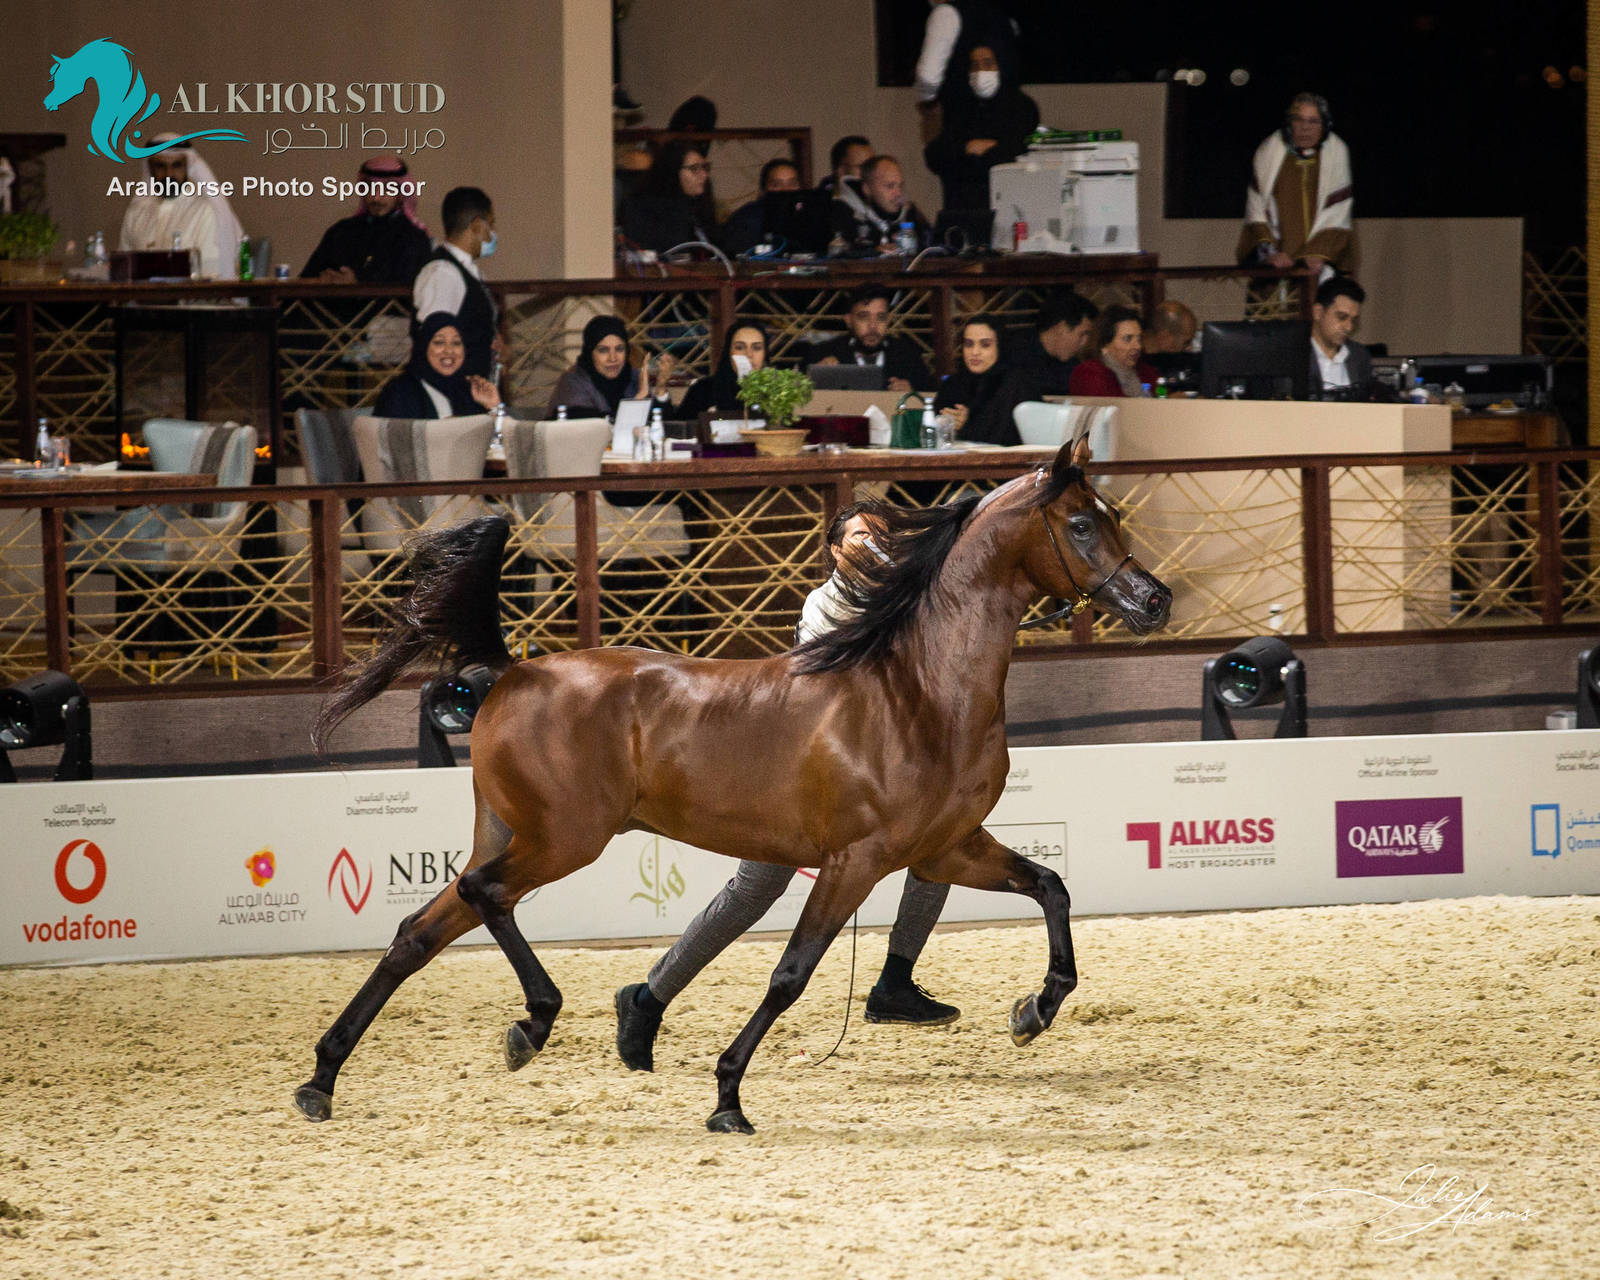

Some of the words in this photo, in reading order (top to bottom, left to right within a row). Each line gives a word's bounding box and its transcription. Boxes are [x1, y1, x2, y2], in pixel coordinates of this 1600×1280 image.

[1409, 767, 1439, 778] Sponsor
[1174, 776, 1196, 784] Media
[1197, 774, 1227, 784] Sponsor
[1004, 784, 1033, 793] ponsor
[346, 806, 383, 816] Diamond
[385, 804, 418, 816] Sponsor
[43, 818, 80, 828] Telecom
[81, 816, 116, 829] Sponsor
[1169, 817, 1275, 846] ALKASS
[1348, 825, 1418, 852] QATAR
[389, 850, 464, 885] NBK
[1168, 860, 1195, 869] HOST
[1200, 857, 1276, 868] BROADCASTER
[278, 910, 306, 922] CITY
[23, 914, 137, 942] vodafone
